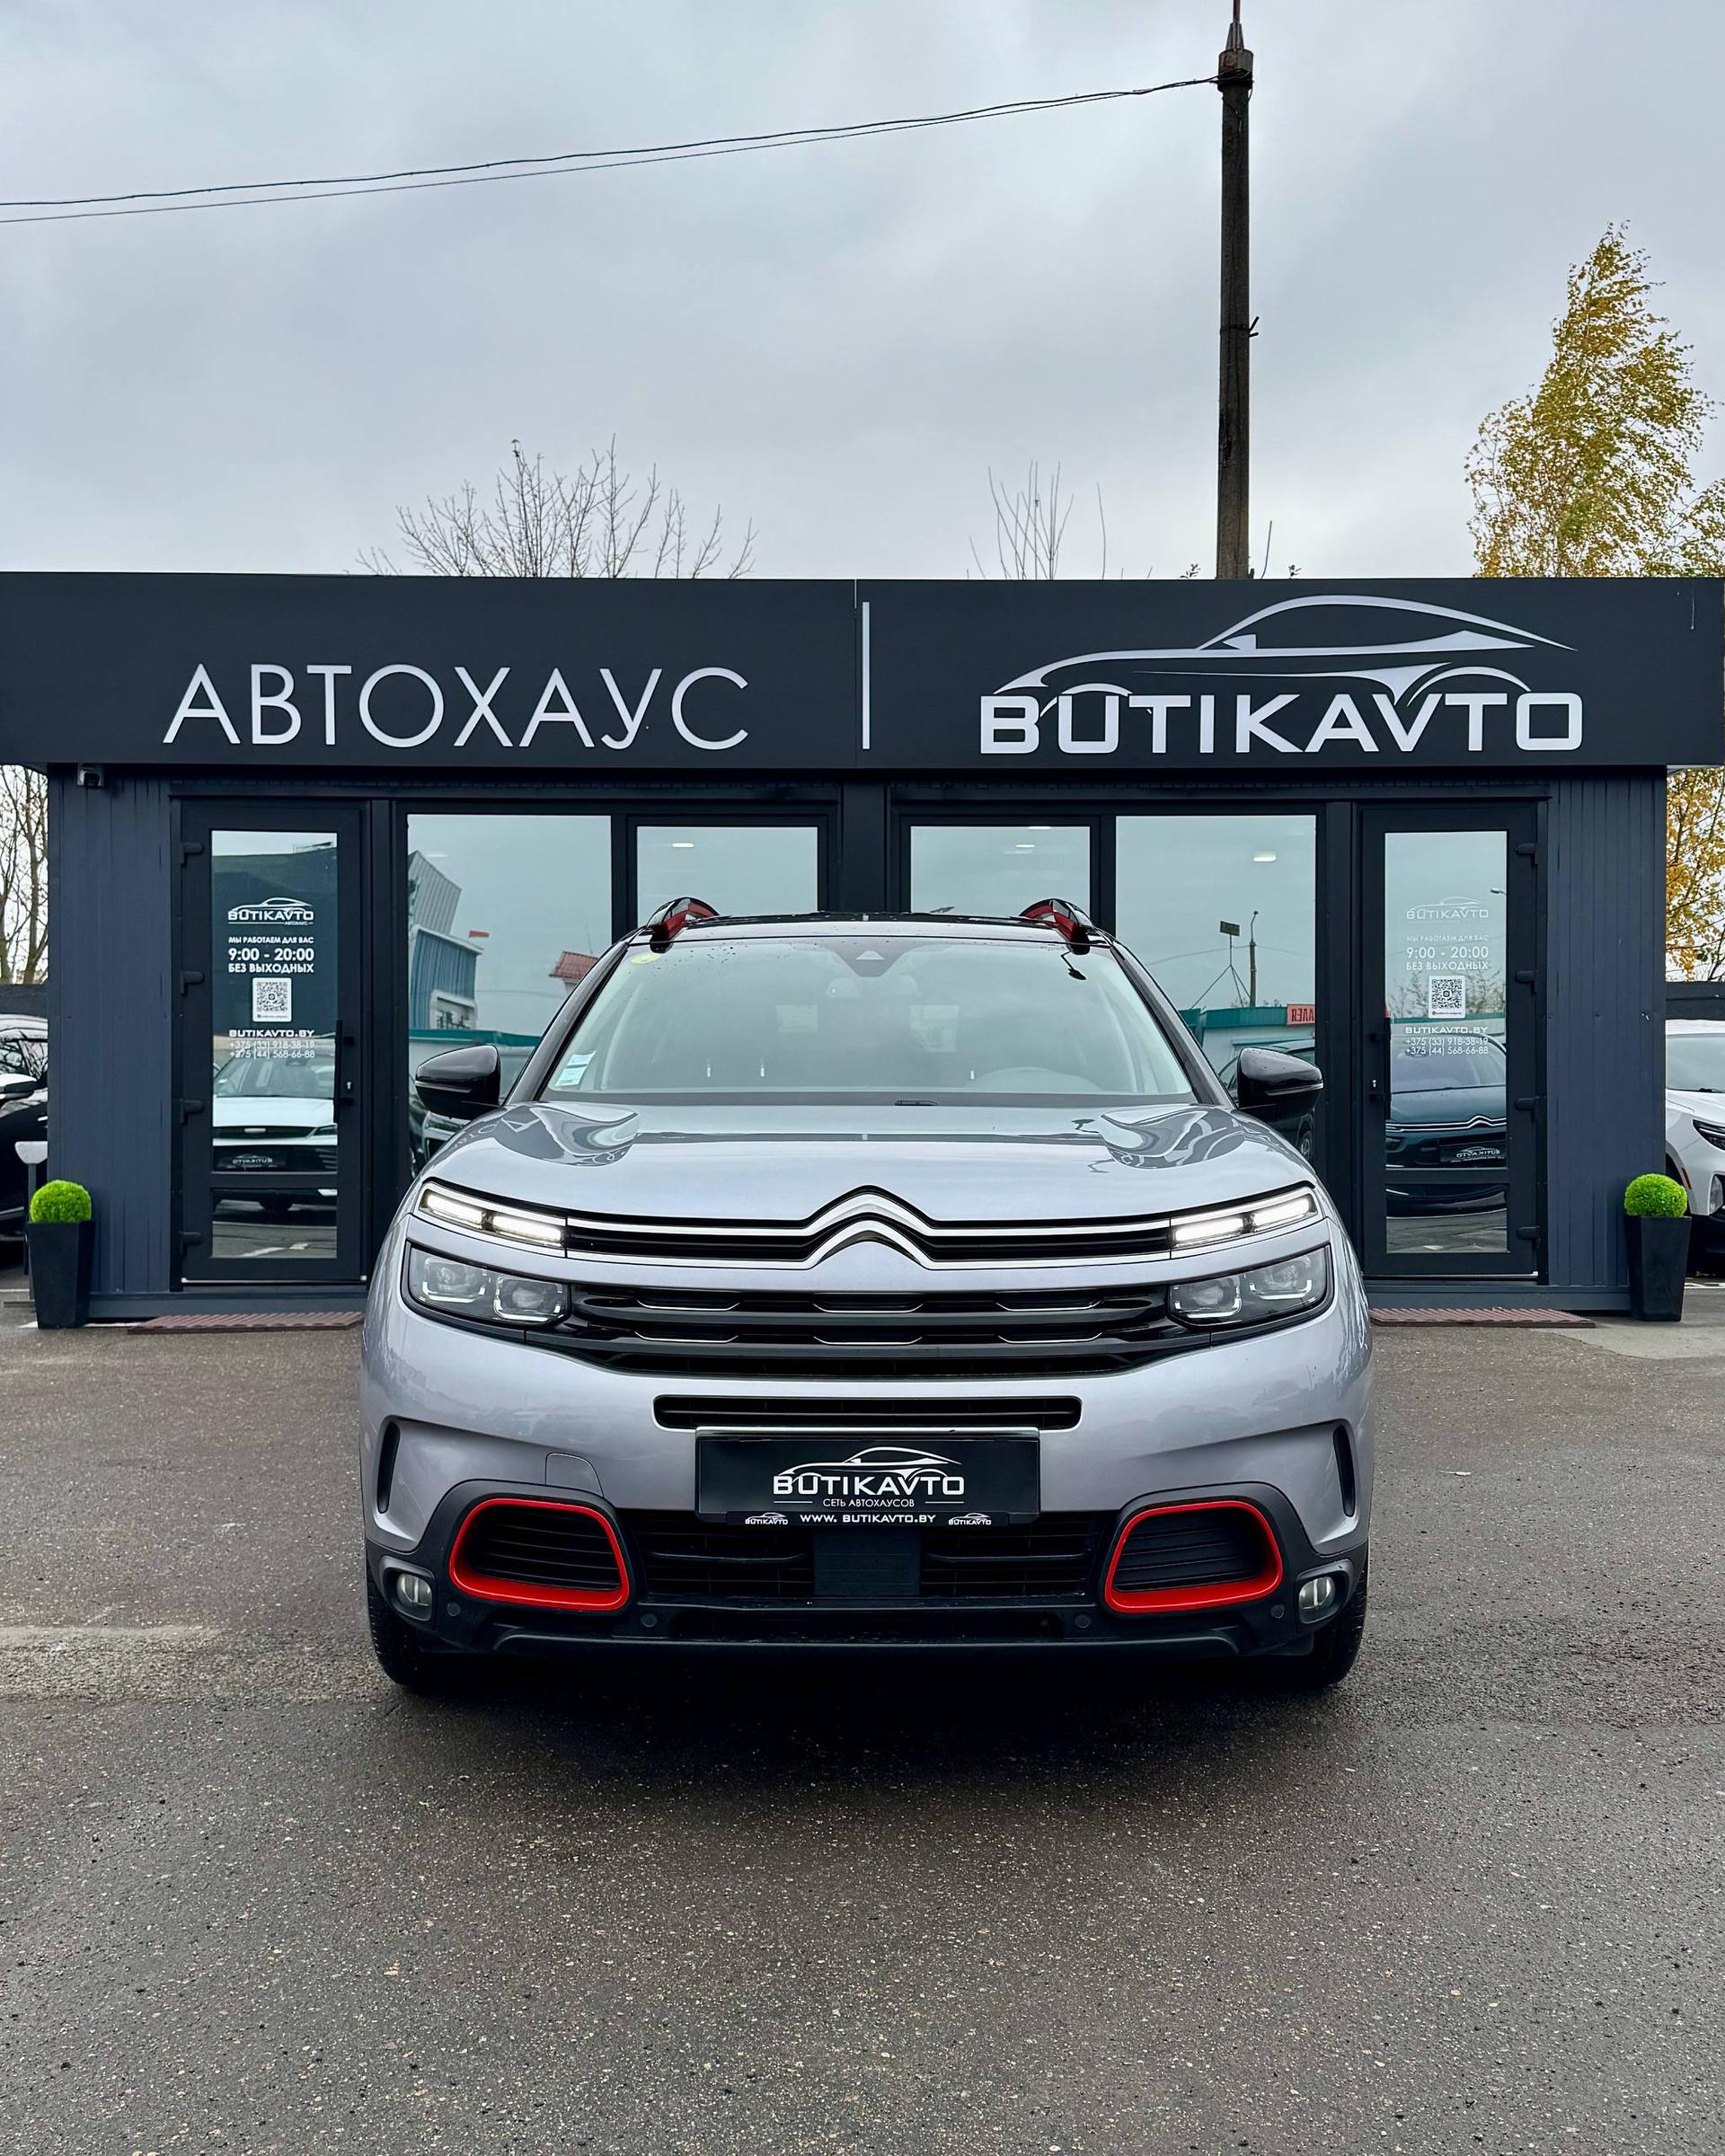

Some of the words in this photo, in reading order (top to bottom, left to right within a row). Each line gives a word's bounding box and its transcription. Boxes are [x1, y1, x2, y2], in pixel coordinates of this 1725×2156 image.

[163, 663, 750, 751] АВТОХАУС
[979, 692, 1585, 755] BUTIKAVTO
[227, 909, 314, 921] BUTIKAVTO
[1405, 908, 1489, 920] BUTIKAVTO
[228, 936, 242, 944] МЫ
[243, 936, 281, 944] РАБОТАЕМ
[282, 936, 297, 945] ДЛЯ
[298, 936, 314, 944] ВАС
[228, 948, 260, 962] 9:00
[274, 948, 314, 962] 20:00
[1406, 946, 1436, 959] 9:00
[1450, 946, 1489, 959] 20:00
[228, 963, 247, 974] БЕЗ
[249, 963, 314, 975] ВЫХОДНЫХ
[1406, 961, 1422, 971] БЕЗ
[1426, 961, 1489, 971] ВЫХОДНЫХ
[228, 1029, 315, 1038] BUTIKAVTO.BY
[1405, 1026, 1489, 1034] BUTIKAVTO.BY
[253, 1039, 270, 1051] (33)
[272, 1040, 314, 1049] 918-38-19
[1405, 1037, 1427, 1046] +375
[1429, 1036, 1445, 1047] (33)
[1446, 1037, 1489, 1046] 918-38-19
[253, 1049, 270, 1060] (44)
[272, 1049, 315, 1058] 568-66-88
[1405, 1046, 1427, 1055] +375
[1429, 1046, 1445, 1056] (44)
[1446, 1046, 1489, 1055] 568-66-88
[773, 1474, 965, 1496] BUTIKAVTO
[822, 1498, 846, 1507] СЕТЬ
[848, 1498, 916, 1508] АВТОХАУСОВ
[800, 1514, 837, 1524] WWW.
[842, 1514, 936, 1524] BUTIKAVTO.BY
